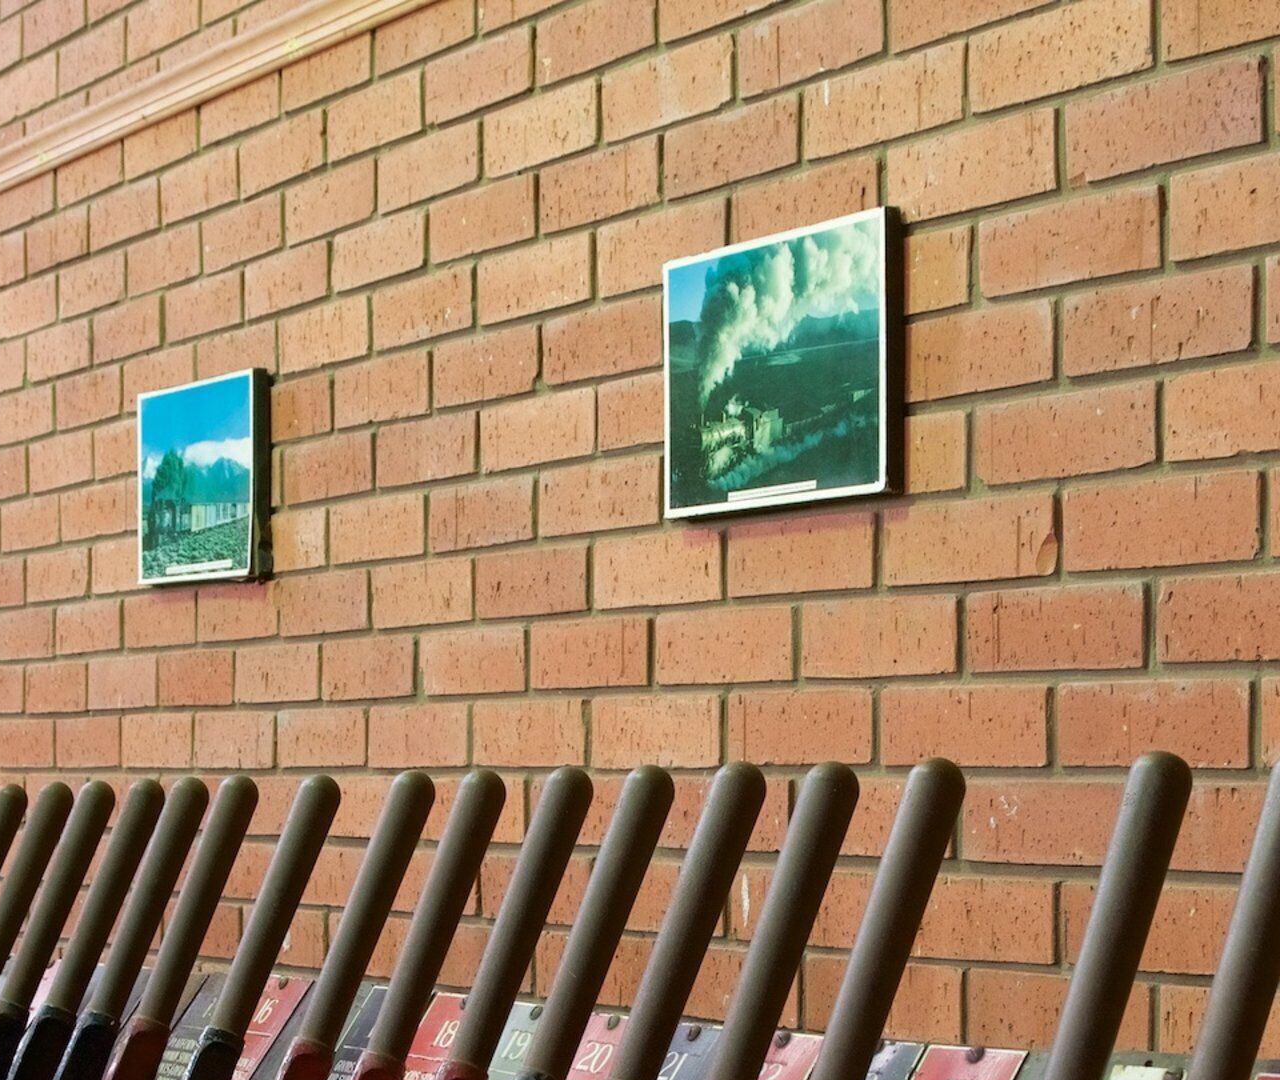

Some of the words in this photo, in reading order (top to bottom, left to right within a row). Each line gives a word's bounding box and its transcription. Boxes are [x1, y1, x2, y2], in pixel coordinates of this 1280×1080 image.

[252, 998, 279, 1025] 16
[433, 1020, 460, 1048] 18
[500, 1031, 532, 1060] 19
[574, 1041, 614, 1074] 20
